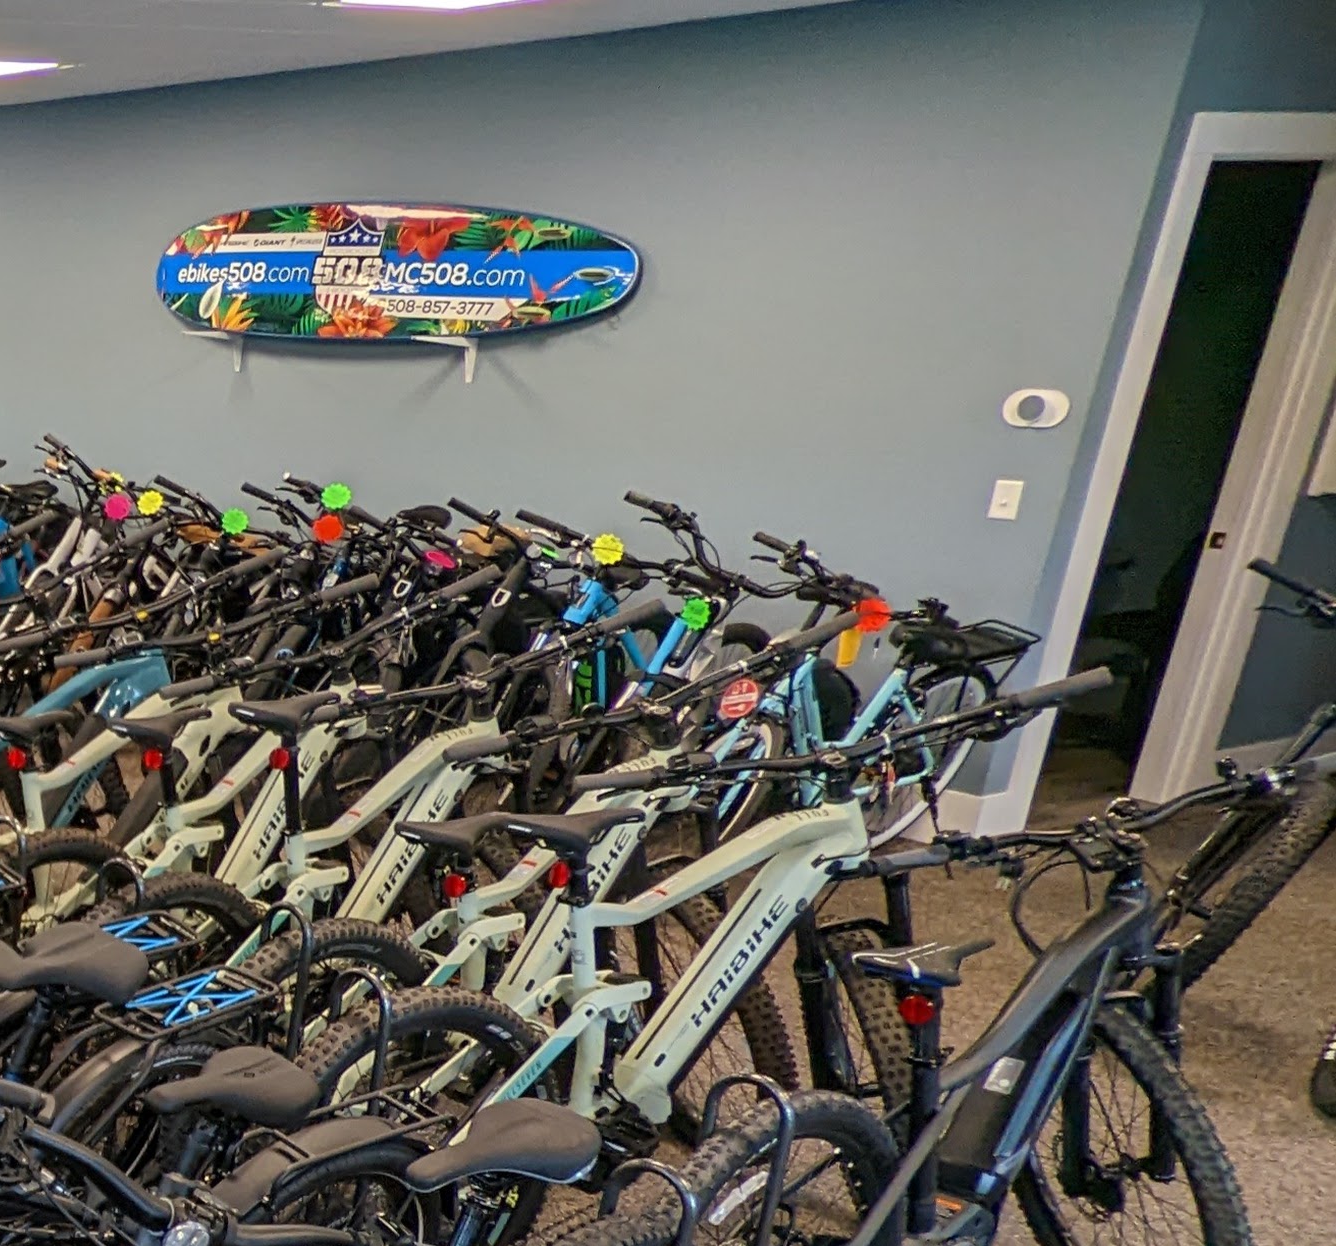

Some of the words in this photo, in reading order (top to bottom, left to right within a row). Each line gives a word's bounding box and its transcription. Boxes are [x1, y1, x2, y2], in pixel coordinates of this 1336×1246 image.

[178, 262, 310, 285] ebikes508.com
[385, 262, 526, 287] MC508.com
[386, 299, 495, 315] 508-857-3777
